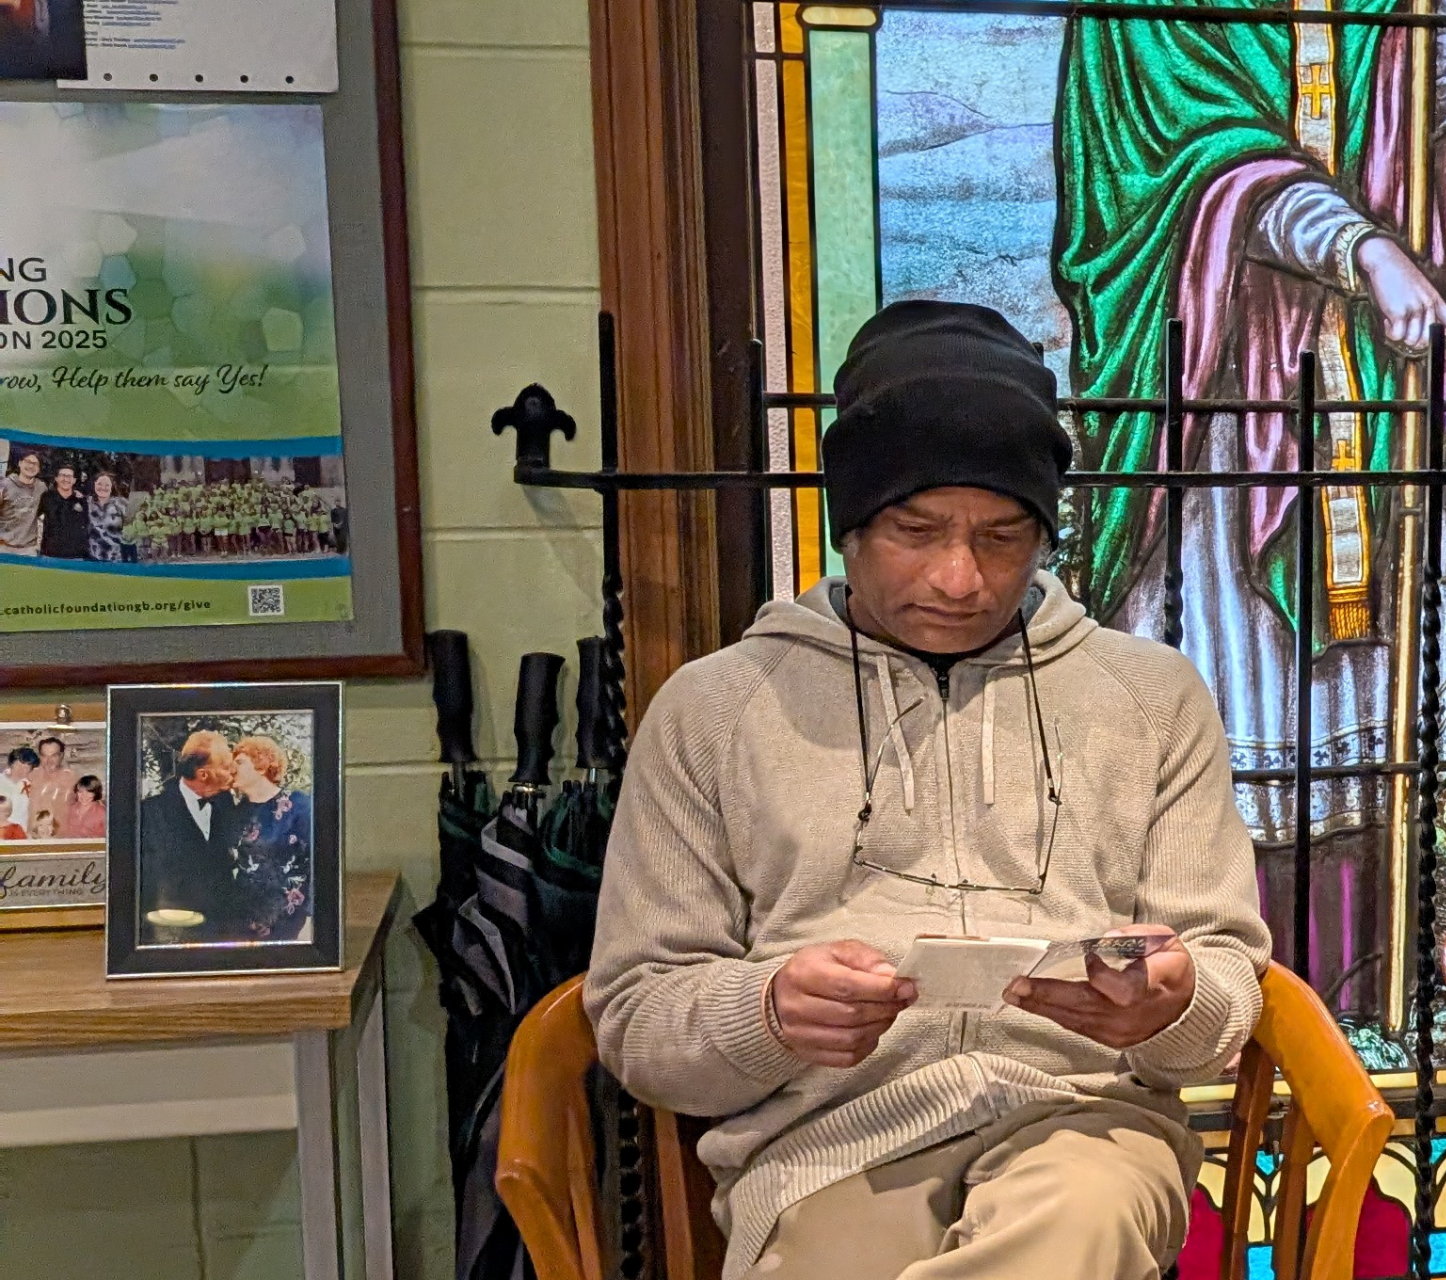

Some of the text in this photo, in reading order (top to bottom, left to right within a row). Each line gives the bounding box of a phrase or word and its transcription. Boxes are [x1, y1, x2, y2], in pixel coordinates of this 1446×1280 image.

[41, 330, 108, 349] 2025
[52, 366, 108, 395] Help
[114, 368, 169, 387] them
[173, 374, 210, 393] say
[216, 364, 269, 394] Yes!
